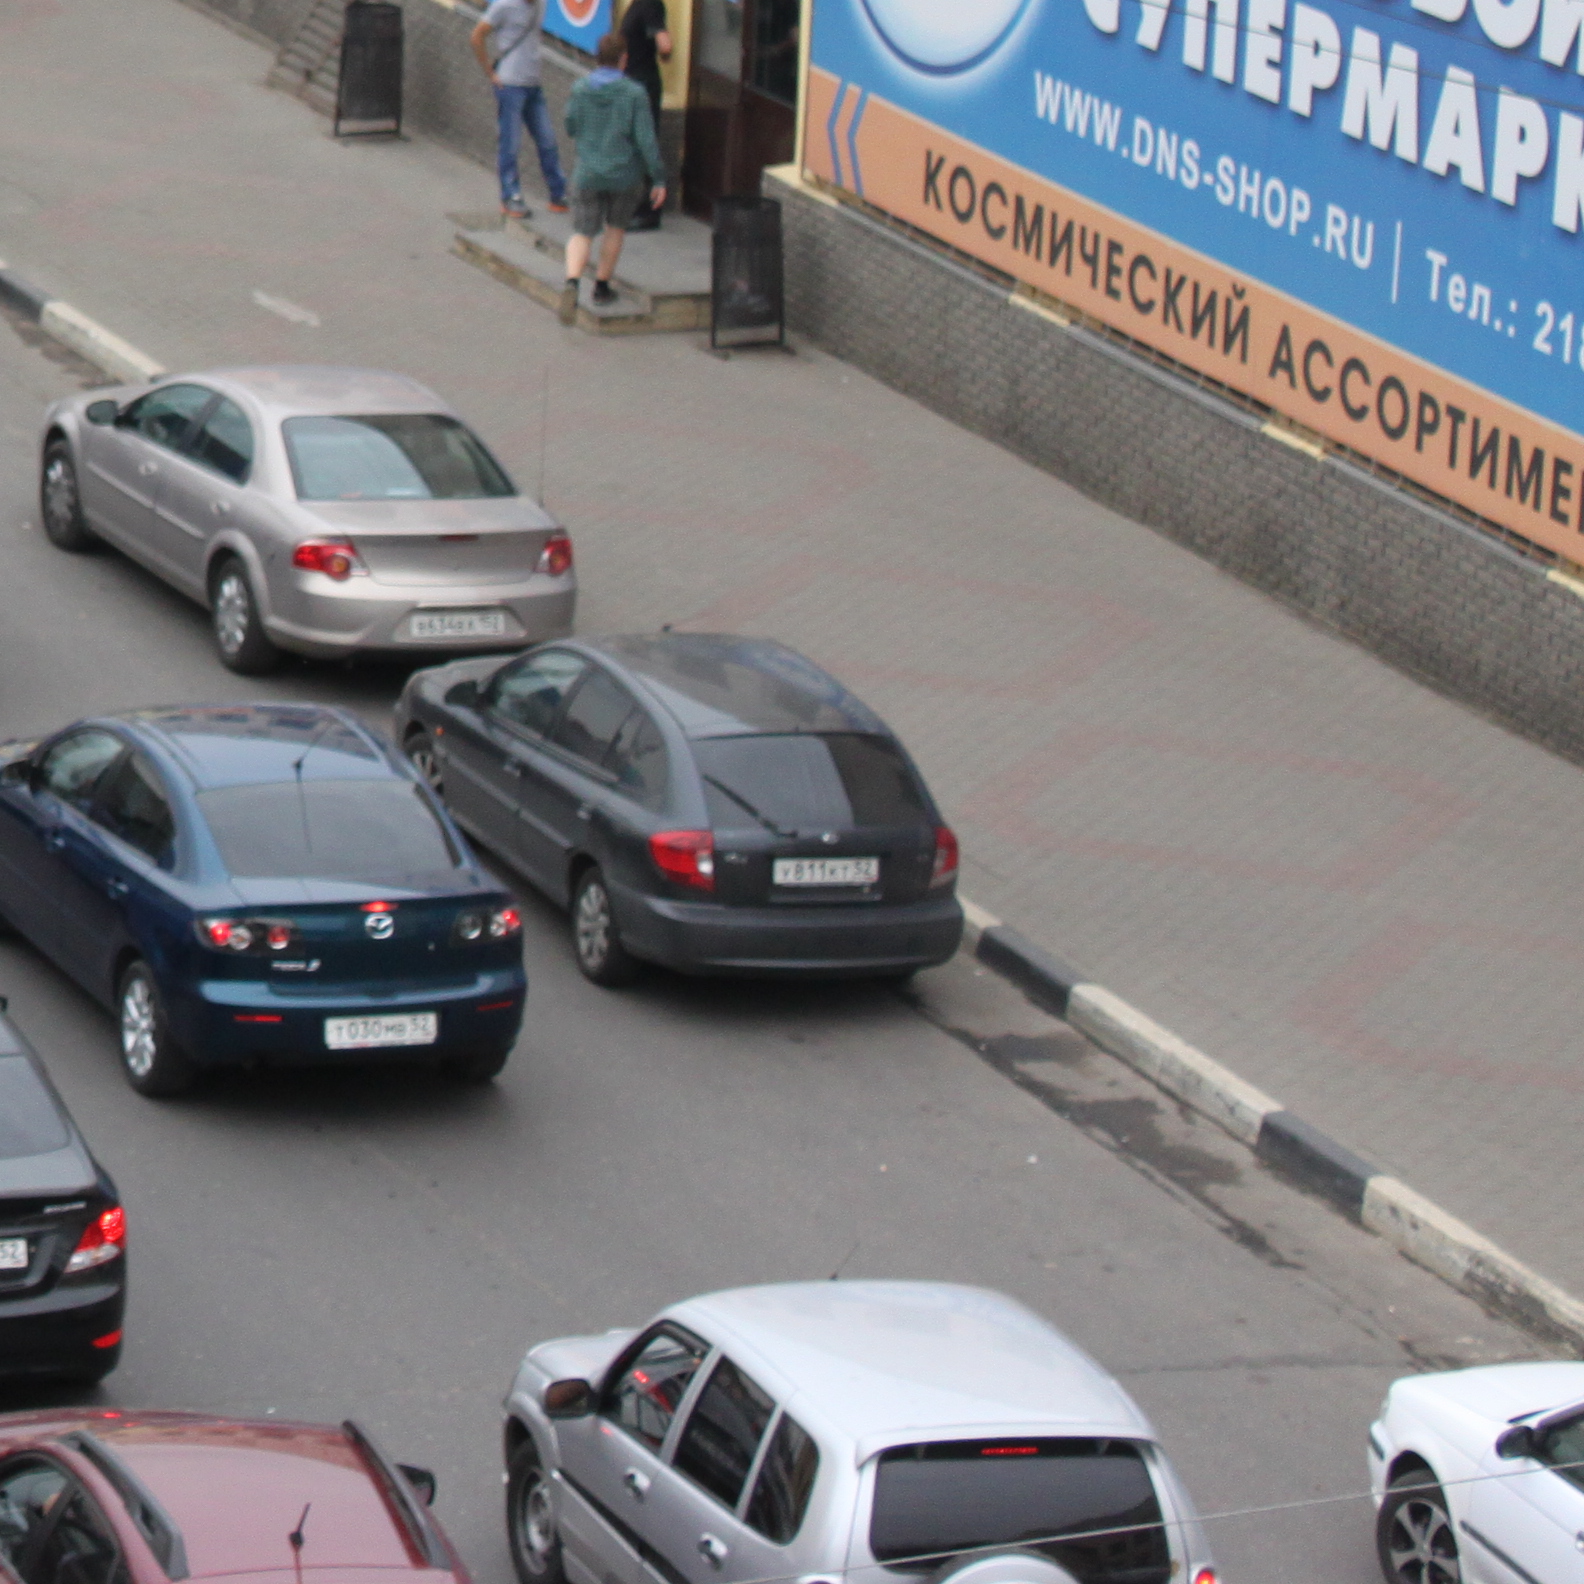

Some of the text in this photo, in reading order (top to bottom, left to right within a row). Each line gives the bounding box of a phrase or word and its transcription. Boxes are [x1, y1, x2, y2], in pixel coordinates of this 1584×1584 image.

[1034, 69, 1374, 270] WWW.DNS-SHOP.RU
[923, 149, 1584, 535] КОСМИЧЕСКИЙ АССОРТИМЕ
[1533, 301, 1584, 372] 21
